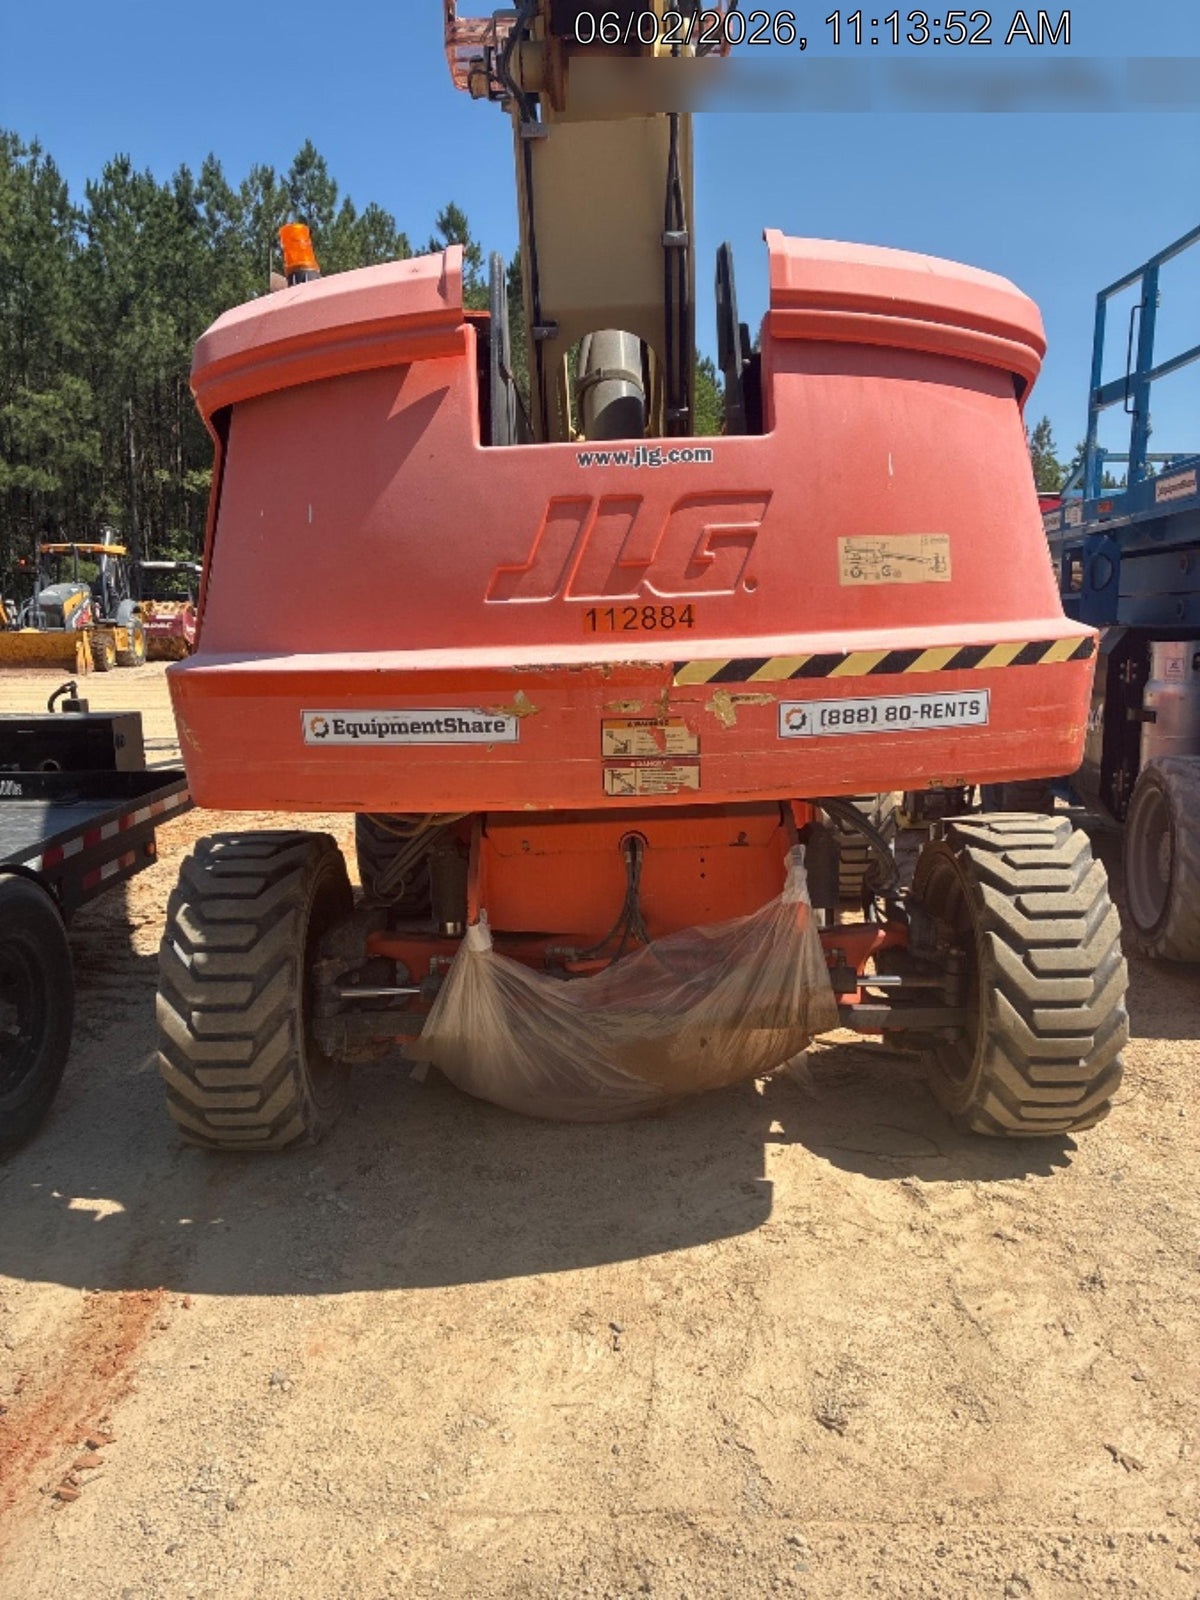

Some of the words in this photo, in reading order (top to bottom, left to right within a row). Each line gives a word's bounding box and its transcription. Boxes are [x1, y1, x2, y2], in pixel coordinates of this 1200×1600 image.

[576, 446, 714, 468] www.jlg.com
[586, 604, 695, 631] 112884
[820, 705, 877, 728] (888)
[884, 700, 981, 721] 80-RENTS
[332, 717, 506, 739] EquipmentShare
